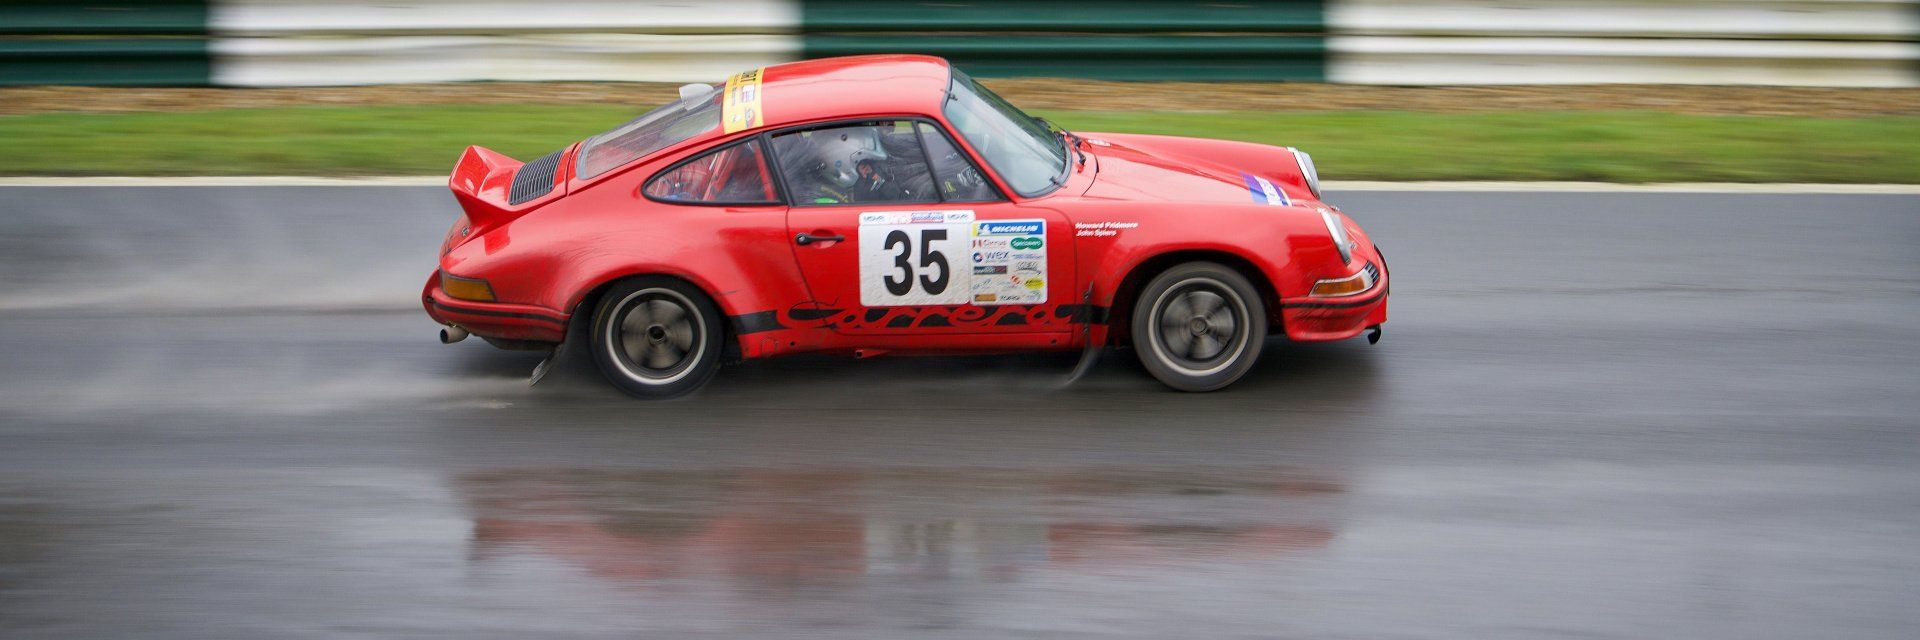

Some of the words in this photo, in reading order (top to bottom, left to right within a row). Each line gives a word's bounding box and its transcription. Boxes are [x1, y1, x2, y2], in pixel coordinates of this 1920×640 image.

[991, 225, 1038, 233] MICHELIN
[883, 229, 950, 296] 35
[776, 302, 1074, 330] Carrera
